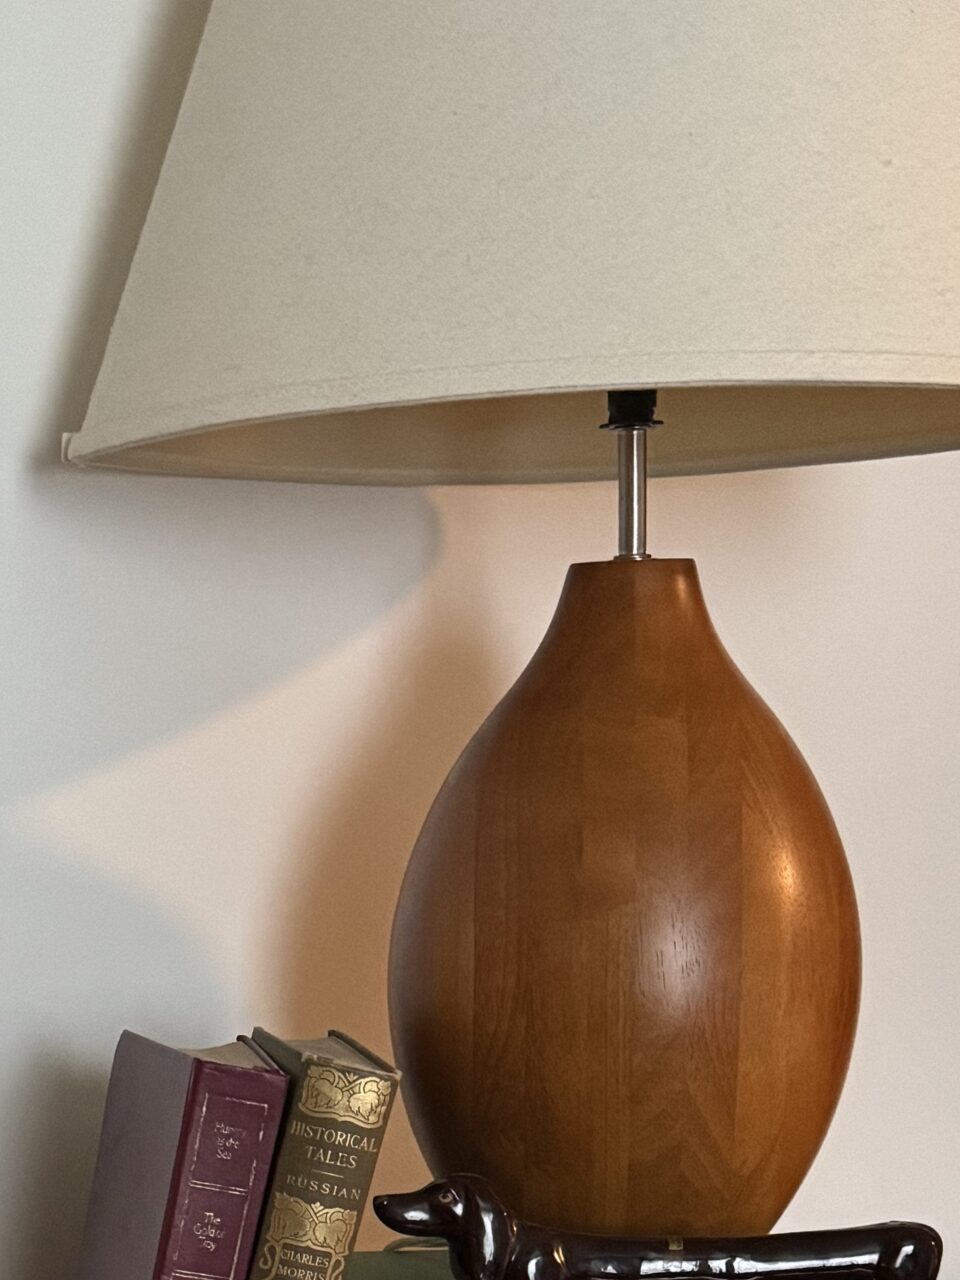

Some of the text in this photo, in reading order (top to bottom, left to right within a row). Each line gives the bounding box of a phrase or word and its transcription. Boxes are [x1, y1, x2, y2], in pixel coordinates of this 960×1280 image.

[290, 1119, 378, 1153] HISTORICAL
[304, 1145, 358, 1169] TALES
[286, 1174, 361, 1201] RUSSIAN
[280, 1248, 330, 1269] CHARLES
